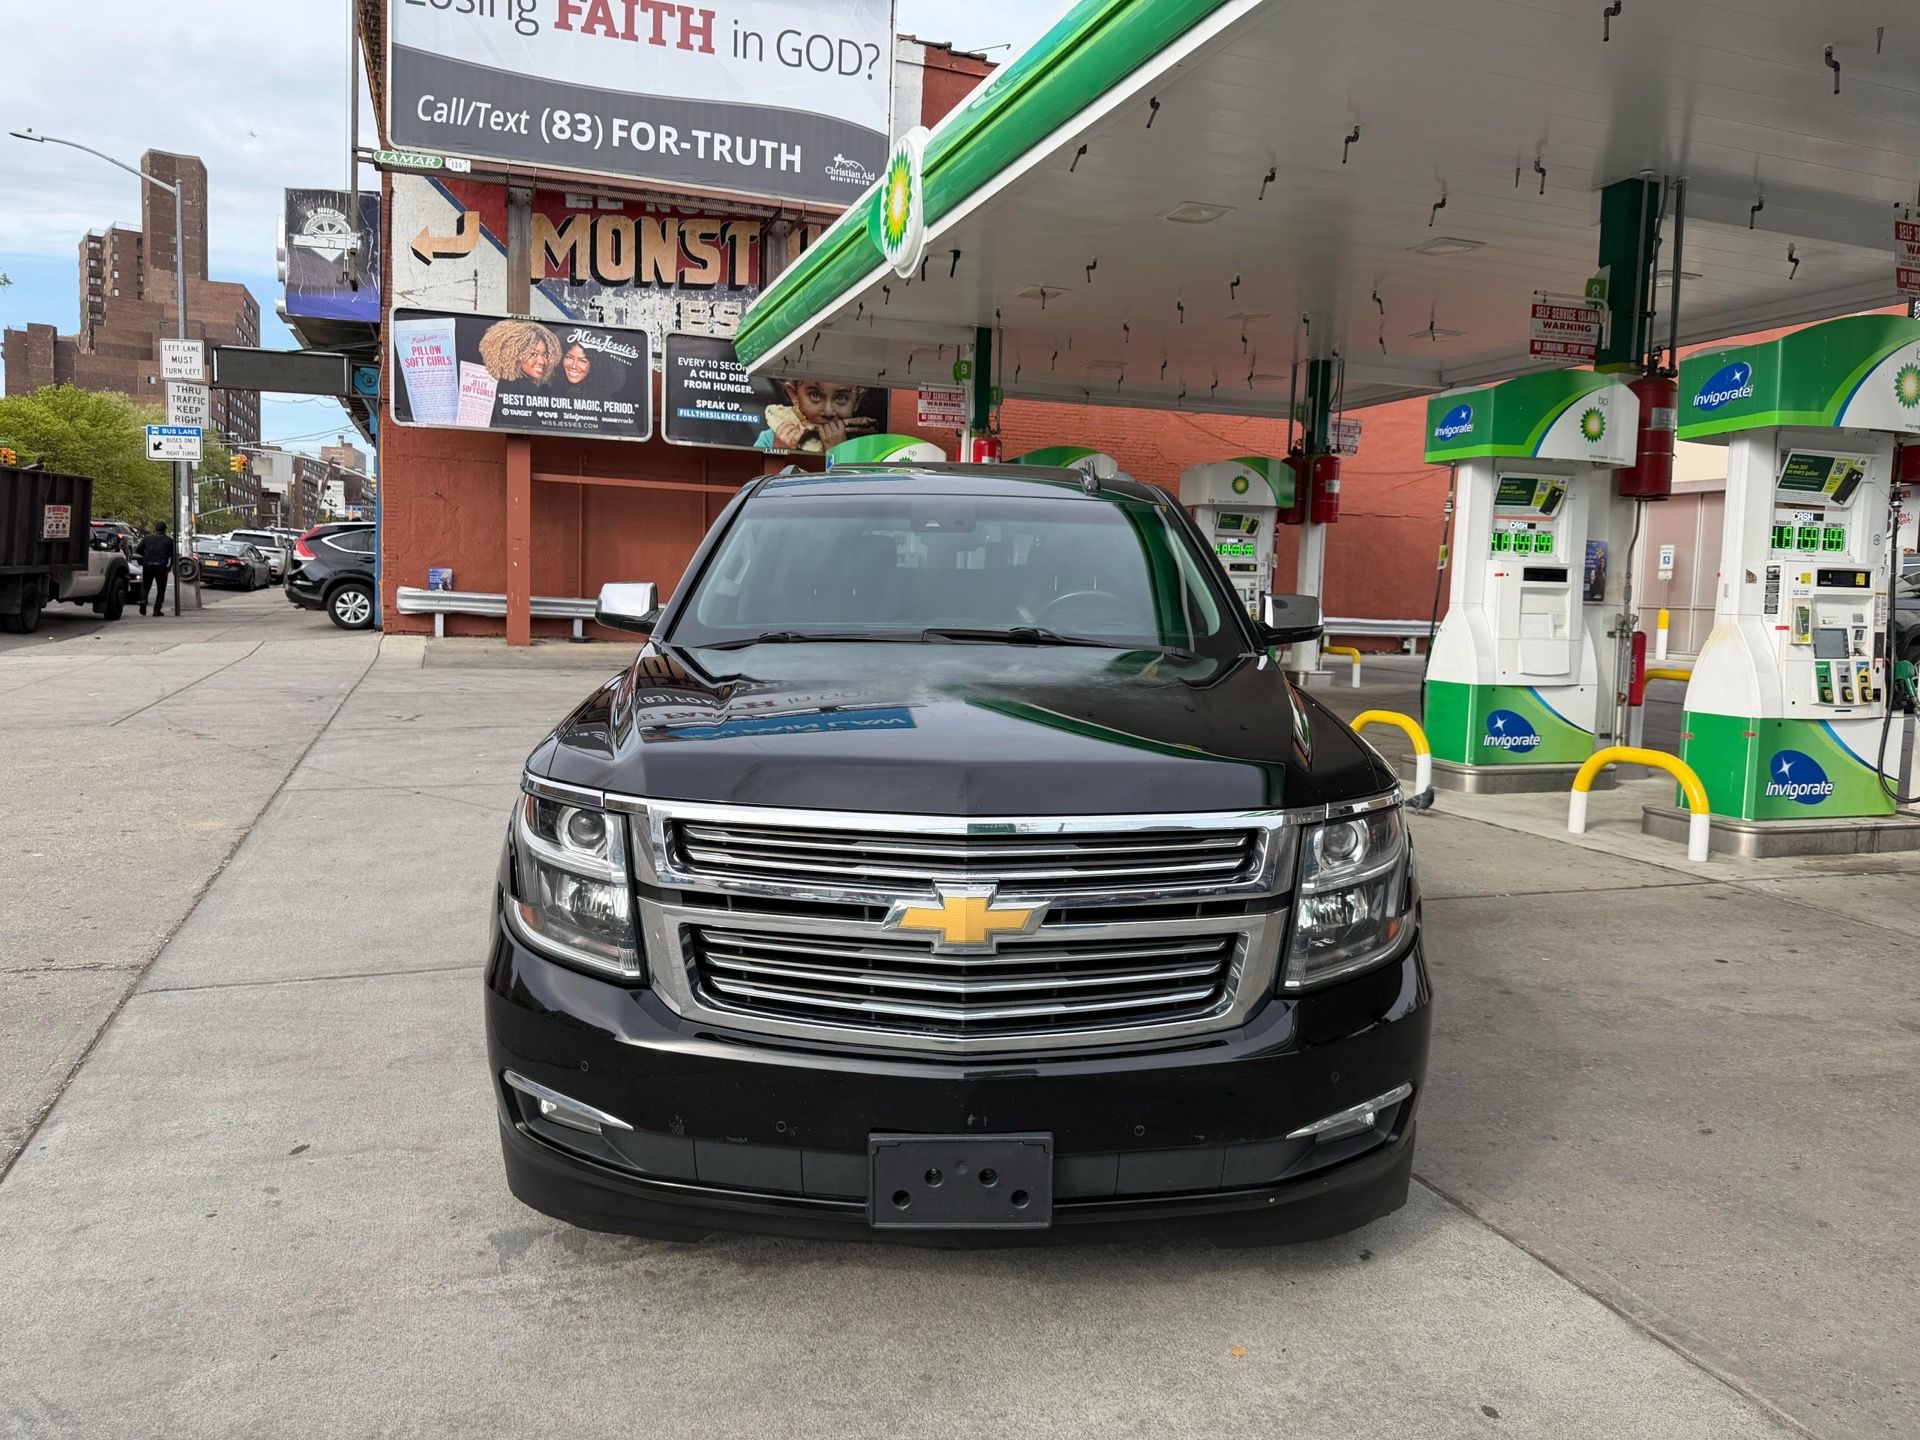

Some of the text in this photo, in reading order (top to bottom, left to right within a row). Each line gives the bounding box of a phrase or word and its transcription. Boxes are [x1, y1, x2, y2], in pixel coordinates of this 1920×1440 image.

[554, 0, 716, 55] FAITH
[733, 19, 763, 61] in
[776, 29, 880, 80] GOD?
[417, 94, 801, 173] Call/Text (83) FOR-TRUTH
[379, 151, 436, 168] LAMAR
[825, 166, 875, 181] Christian Aid
[1899, 224, 1913, 239] SELF
[1592, 284, 1600, 298] 8
[1535, 305, 1551, 318] SELF
[1552, 307, 1577, 321] SERVICE
[1543, 321, 1591, 333] WARNING
[164, 344, 199, 353] LEFT LANE
[567, 328, 639, 359] Miss Jessie's
[411, 345, 442, 356] PILLOW
[171, 356, 193, 364] MUST
[405, 356, 452, 368] SOFT CURLS
[677, 356, 706, 368] EVERY
[707, 359, 718, 369] 10
[165, 367, 182, 375] TURN
[690, 369, 749, 382] A CHILD DIES
[961, 363, 968, 375] 9
[176, 385, 201, 395] THRU
[684, 379, 755, 395] FROM HUNGER.
[172, 394, 206, 405] TRAFFIC
[1598, 396, 1608, 406] bp
[1692, 385, 1753, 406] Invigorate
[176, 405, 200, 414] KEEP
[526, 397, 549, 408] DARN
[551, 398, 572, 410] CURL
[574, 399, 602, 412] MAGIC,
[696, 399, 742, 412] SPEAK UP.
[174, 415, 202, 424] RIGHT
[509, 409, 533, 417] TARGET
[679, 409, 759, 423] FILLTHESILENCE.ORG
[178, 427, 197, 435] LANE
[541, 420, 599, 429] MISSJESSIES.COM
[1435, 422, 1473, 438] Invigorate
[908, 448, 917, 457] bp
[1792, 512, 1814, 521] CASH
[1483, 734, 1541, 749] Invigorate
[1765, 780, 1834, 800] Invigorate
